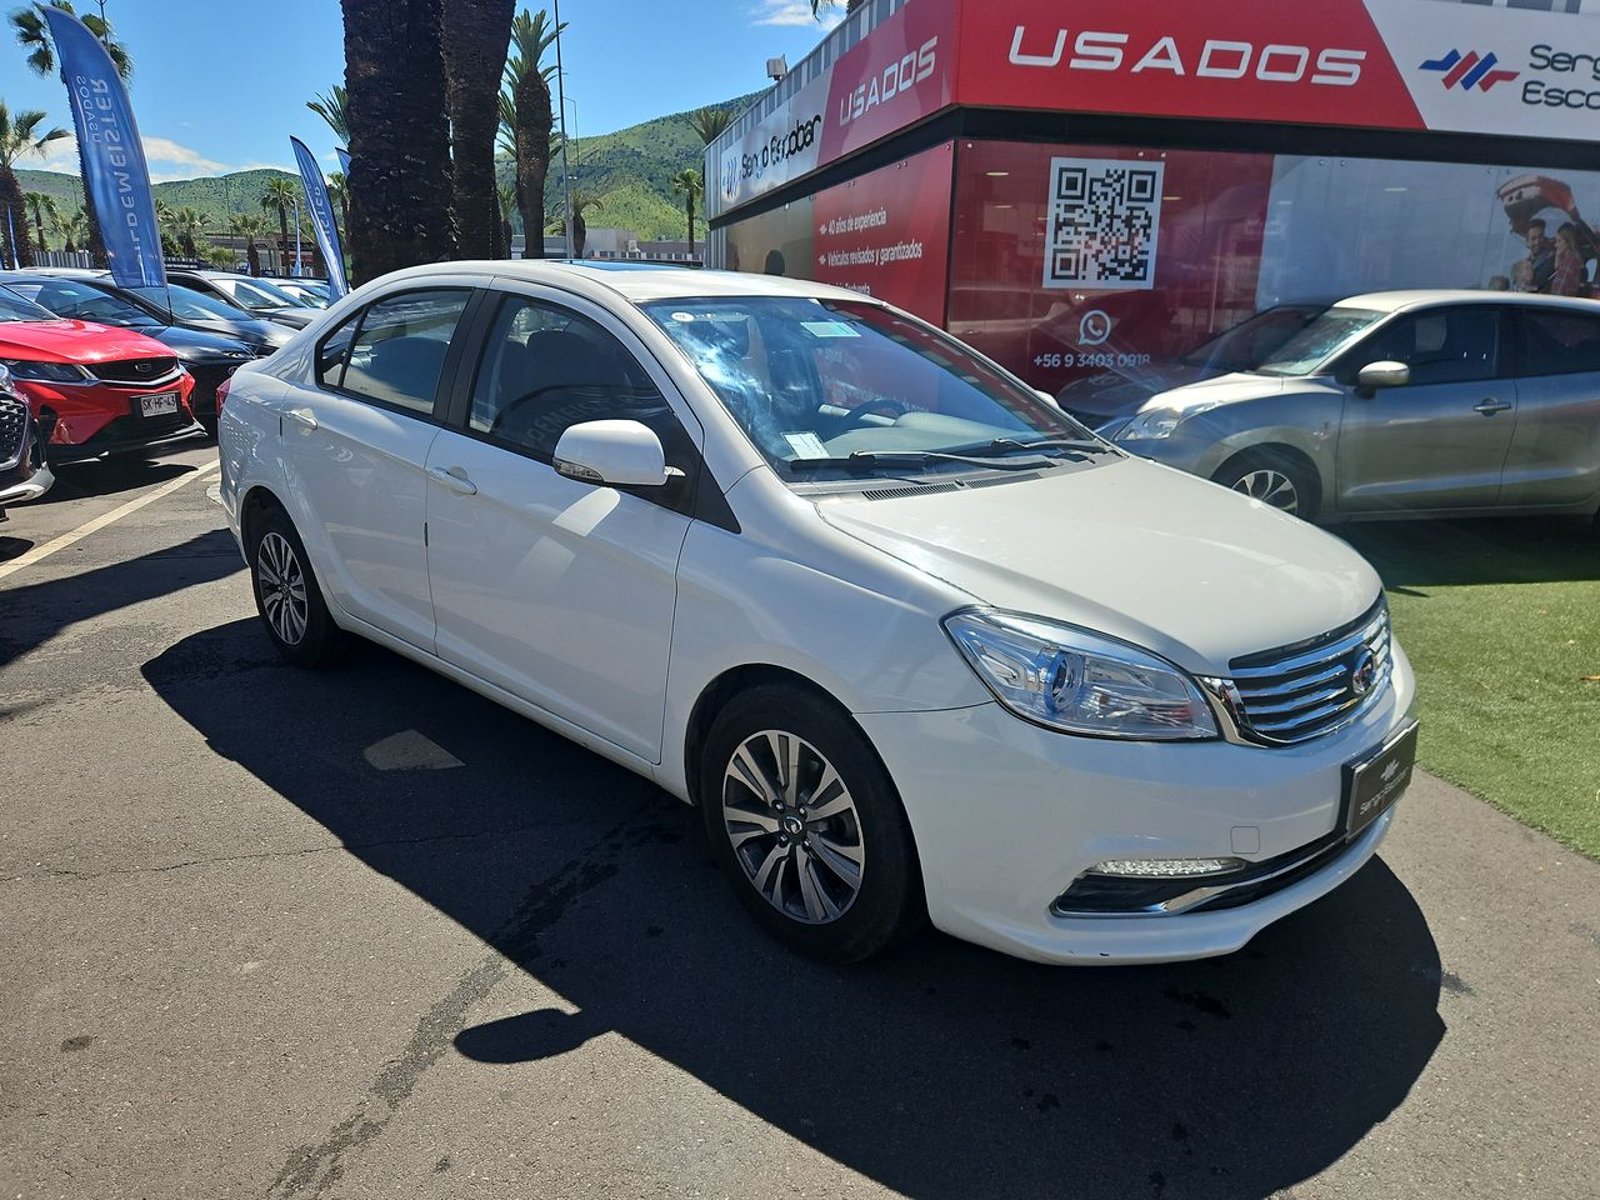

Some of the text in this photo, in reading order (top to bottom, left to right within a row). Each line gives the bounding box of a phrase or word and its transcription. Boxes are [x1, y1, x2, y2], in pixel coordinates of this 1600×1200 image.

[1008, 25, 1368, 86] USADOS
[839, 35, 938, 127] USADOS
[854, 205, 887, 232] experiencia
[880, 238, 922, 266] garantizados
[1033, 353, 1061, 368] +56
[1064, 353, 1075, 368] 9
